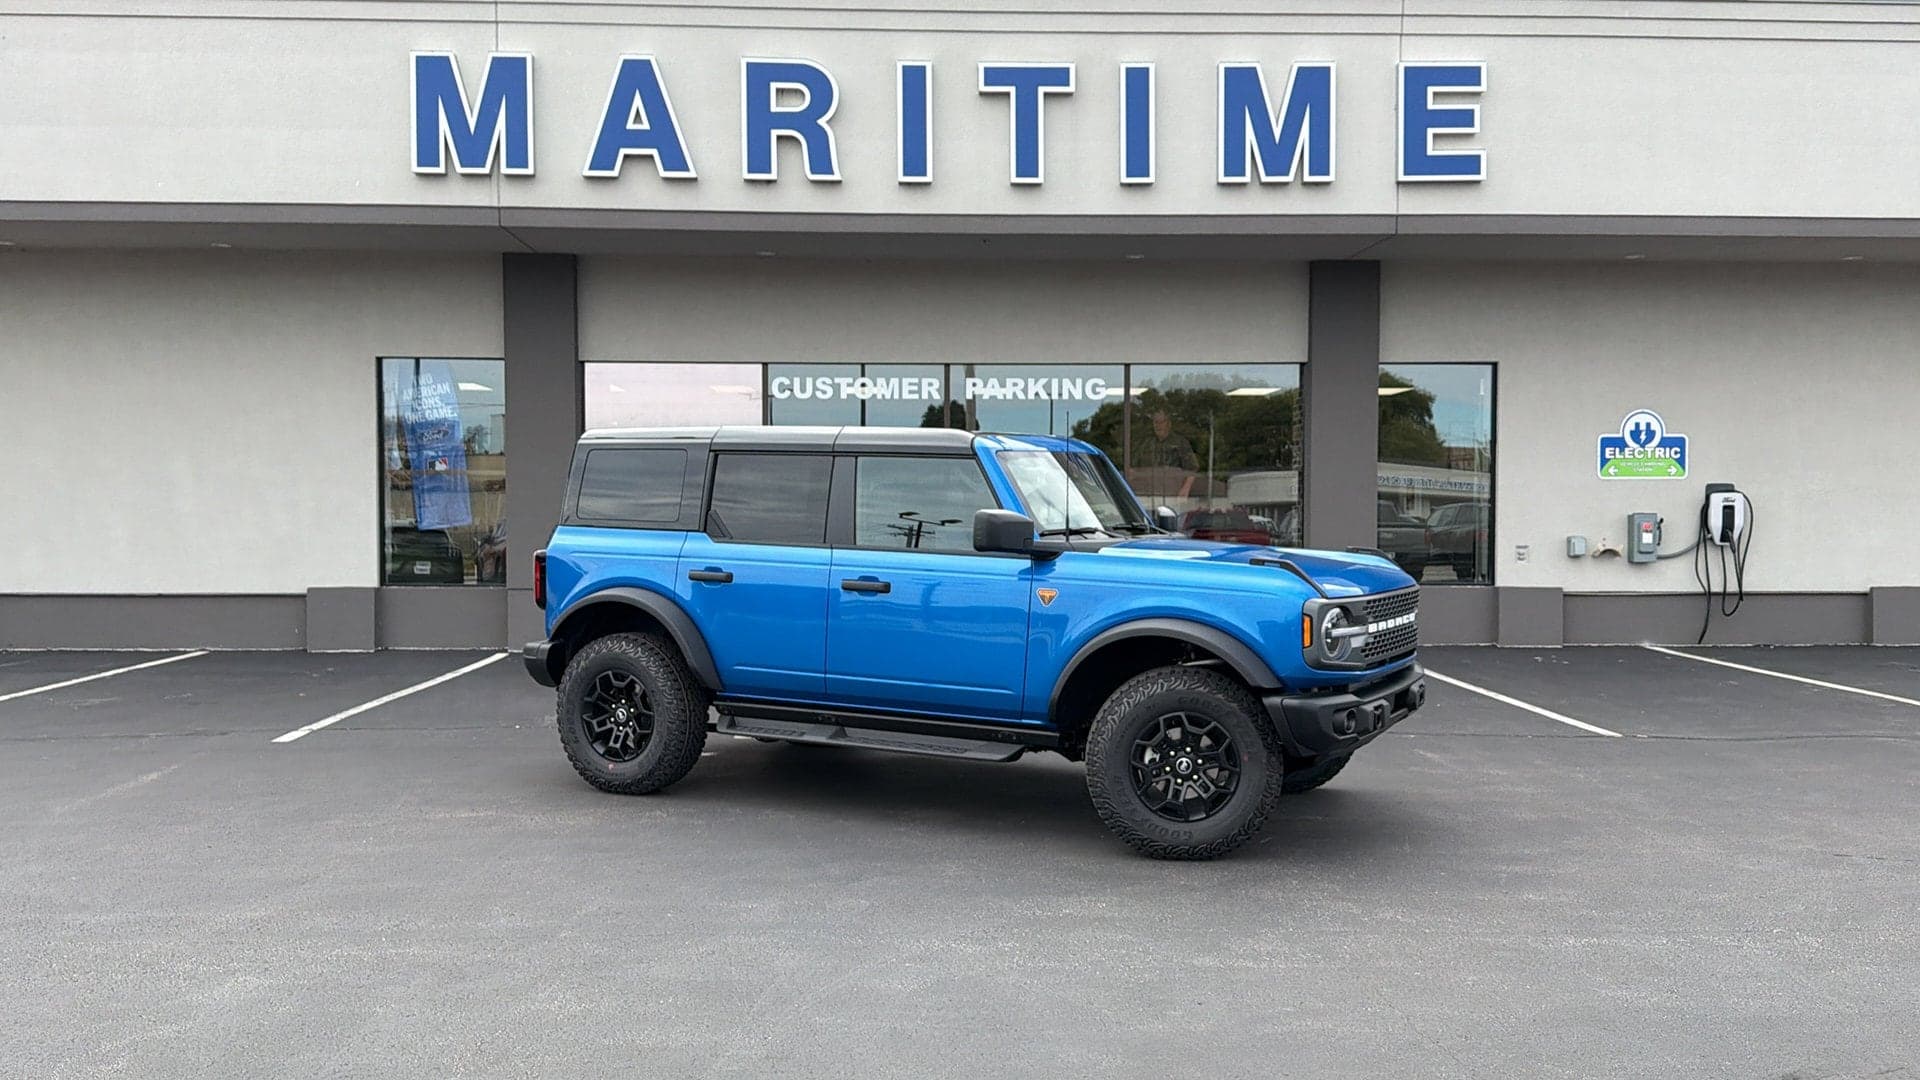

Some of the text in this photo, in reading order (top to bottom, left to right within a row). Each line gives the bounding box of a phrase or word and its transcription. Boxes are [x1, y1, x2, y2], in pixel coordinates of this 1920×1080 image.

[409, 50, 1488, 186] MARITIME
[771, 376, 1107, 400] CUSTOMER PARKING
[1605, 447, 1681, 459] ELECTRIC
[1368, 612, 1416, 633] BRONCO
